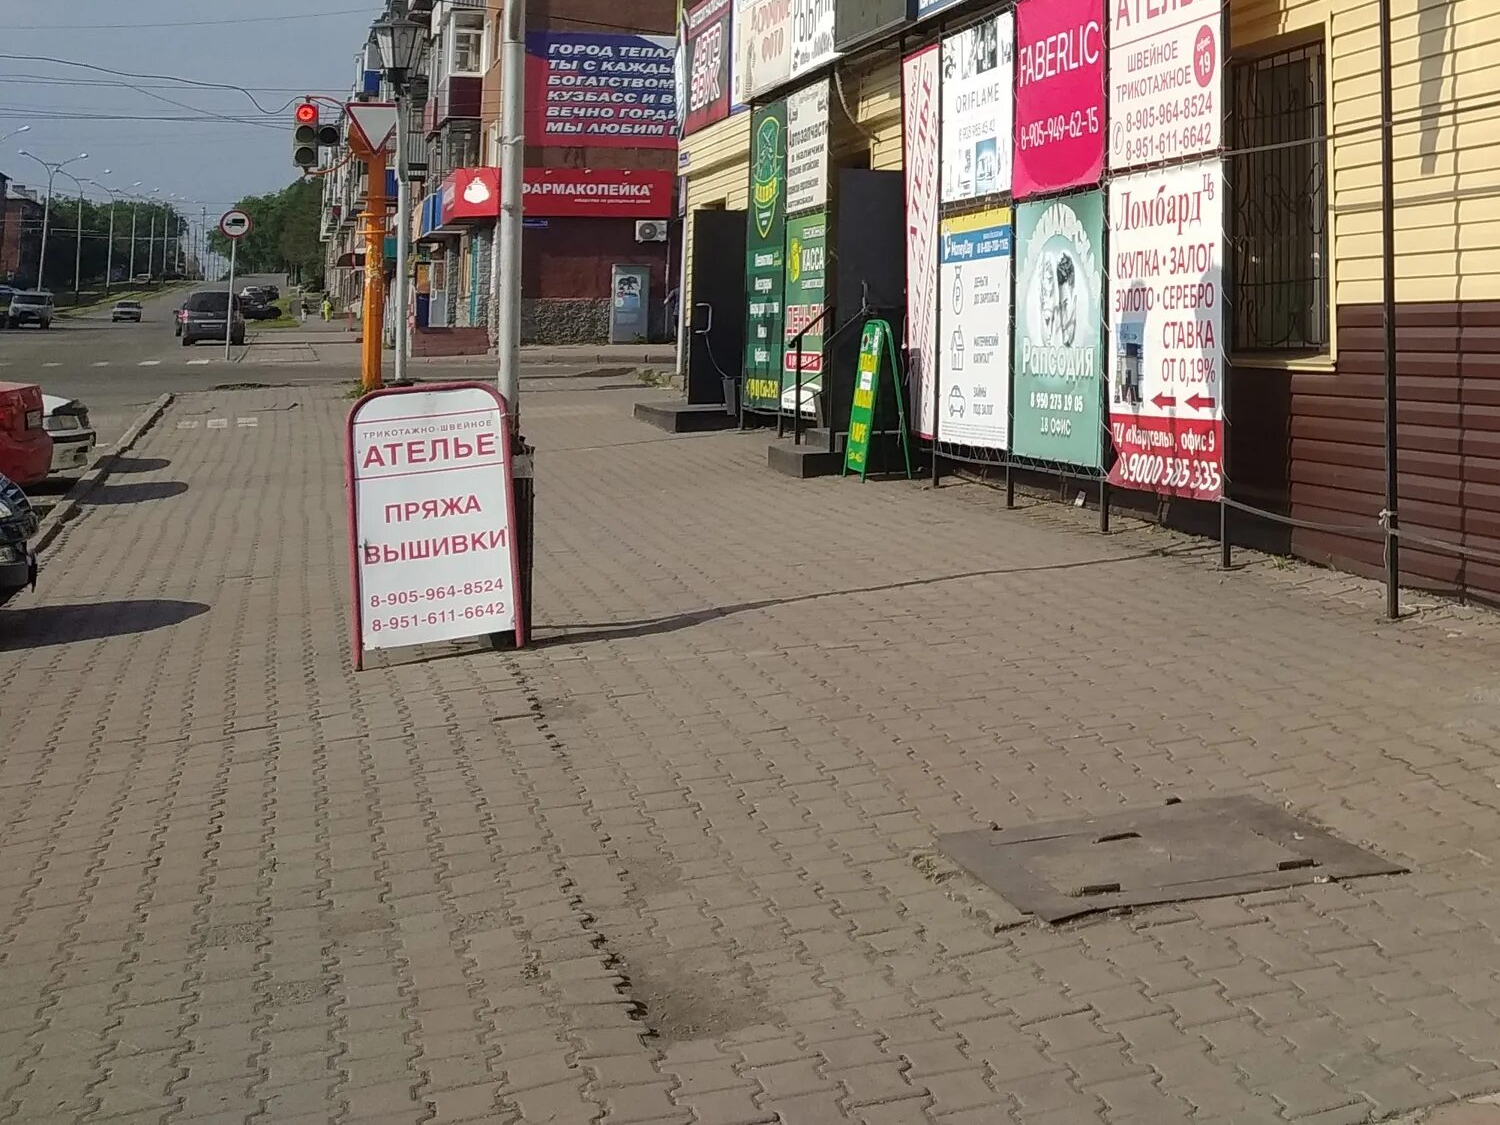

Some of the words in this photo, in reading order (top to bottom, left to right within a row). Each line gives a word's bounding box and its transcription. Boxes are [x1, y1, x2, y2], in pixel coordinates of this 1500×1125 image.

[548, 44, 613, 57] ГОРОД
[619, 46, 677, 57] ТЕПЛА
[692, 21, 721, 76] АВТО
[1019, 21, 1100, 88] FABERLIC
[1127, 40, 1179, 73] ШВЕЙНОЕ
[1199, 51, 1211, 76] 19
[548, 59, 578, 70] ТЫ
[583, 60, 600, 70] С
[547, 76, 676, 88] БОГАТСТВОМ
[547, 91, 637, 103] КУЗБАСС
[641, 94, 656, 103] И
[690, 59, 721, 111] ЗВУК
[1116, 65, 1192, 104] ТРИКОТАЖНОЕ
[546, 106, 614, 118] ВЕЧНО
[955, 82, 1000, 114] ORIFLAME
[1126, 91, 1213, 133] 8-905-964-8524
[546, 121, 583, 132] МЫ
[587, 123, 662, 135] ЛЮБИМ
[1020, 106, 1100, 151] 8-905-949-62-15
[1126, 122, 1211, 161] 8-951-611-6642
[796, 143, 825, 161] наличии
[910, 61, 933, 261] АТЕЛЬЕ
[1115, 185, 1202, 235] Ломбард
[802, 247, 825, 271] КАССА
[1116, 249, 1160, 280] СКУПКА
[1170, 242, 1214, 275] ЗАЛОГ
[1116, 287, 1154, 312] ЗОЛОТО
[1162, 282, 1214, 310] СЕРЕБРО
[785, 303, 824, 343] ДЕНЬГИ
[1163, 320, 1215, 349] СТАВКА
[1022, 335, 1094, 382] Рапсодия
[1162, 358, 1176, 382] ОТ
[1180, 357, 1216, 387] 0,19%
[1063, 394, 1072, 411] 19
[362, 419, 493, 439] ТРИКОТАЖНО-ШВЕЙНОЕ
[1040, 416, 1048, 433] 18
[1050, 417, 1072, 436] ОФИС
[362, 432, 497, 469] АТЕЛЬЕ
[1181, 428, 1207, 455] офис
[1208, 430, 1215, 452] 9
[1129, 453, 1163, 485] 9000
[1161, 457, 1190, 487] 585
[1190, 460, 1221, 491] 335
[385, 495, 482, 524] ПРЯЖА
[364, 528, 507, 566] ВЫШИВКИ
[370, 578, 505, 608] 8-905-964-8524
[372, 601, 506, 632] 8-951-611-6642
